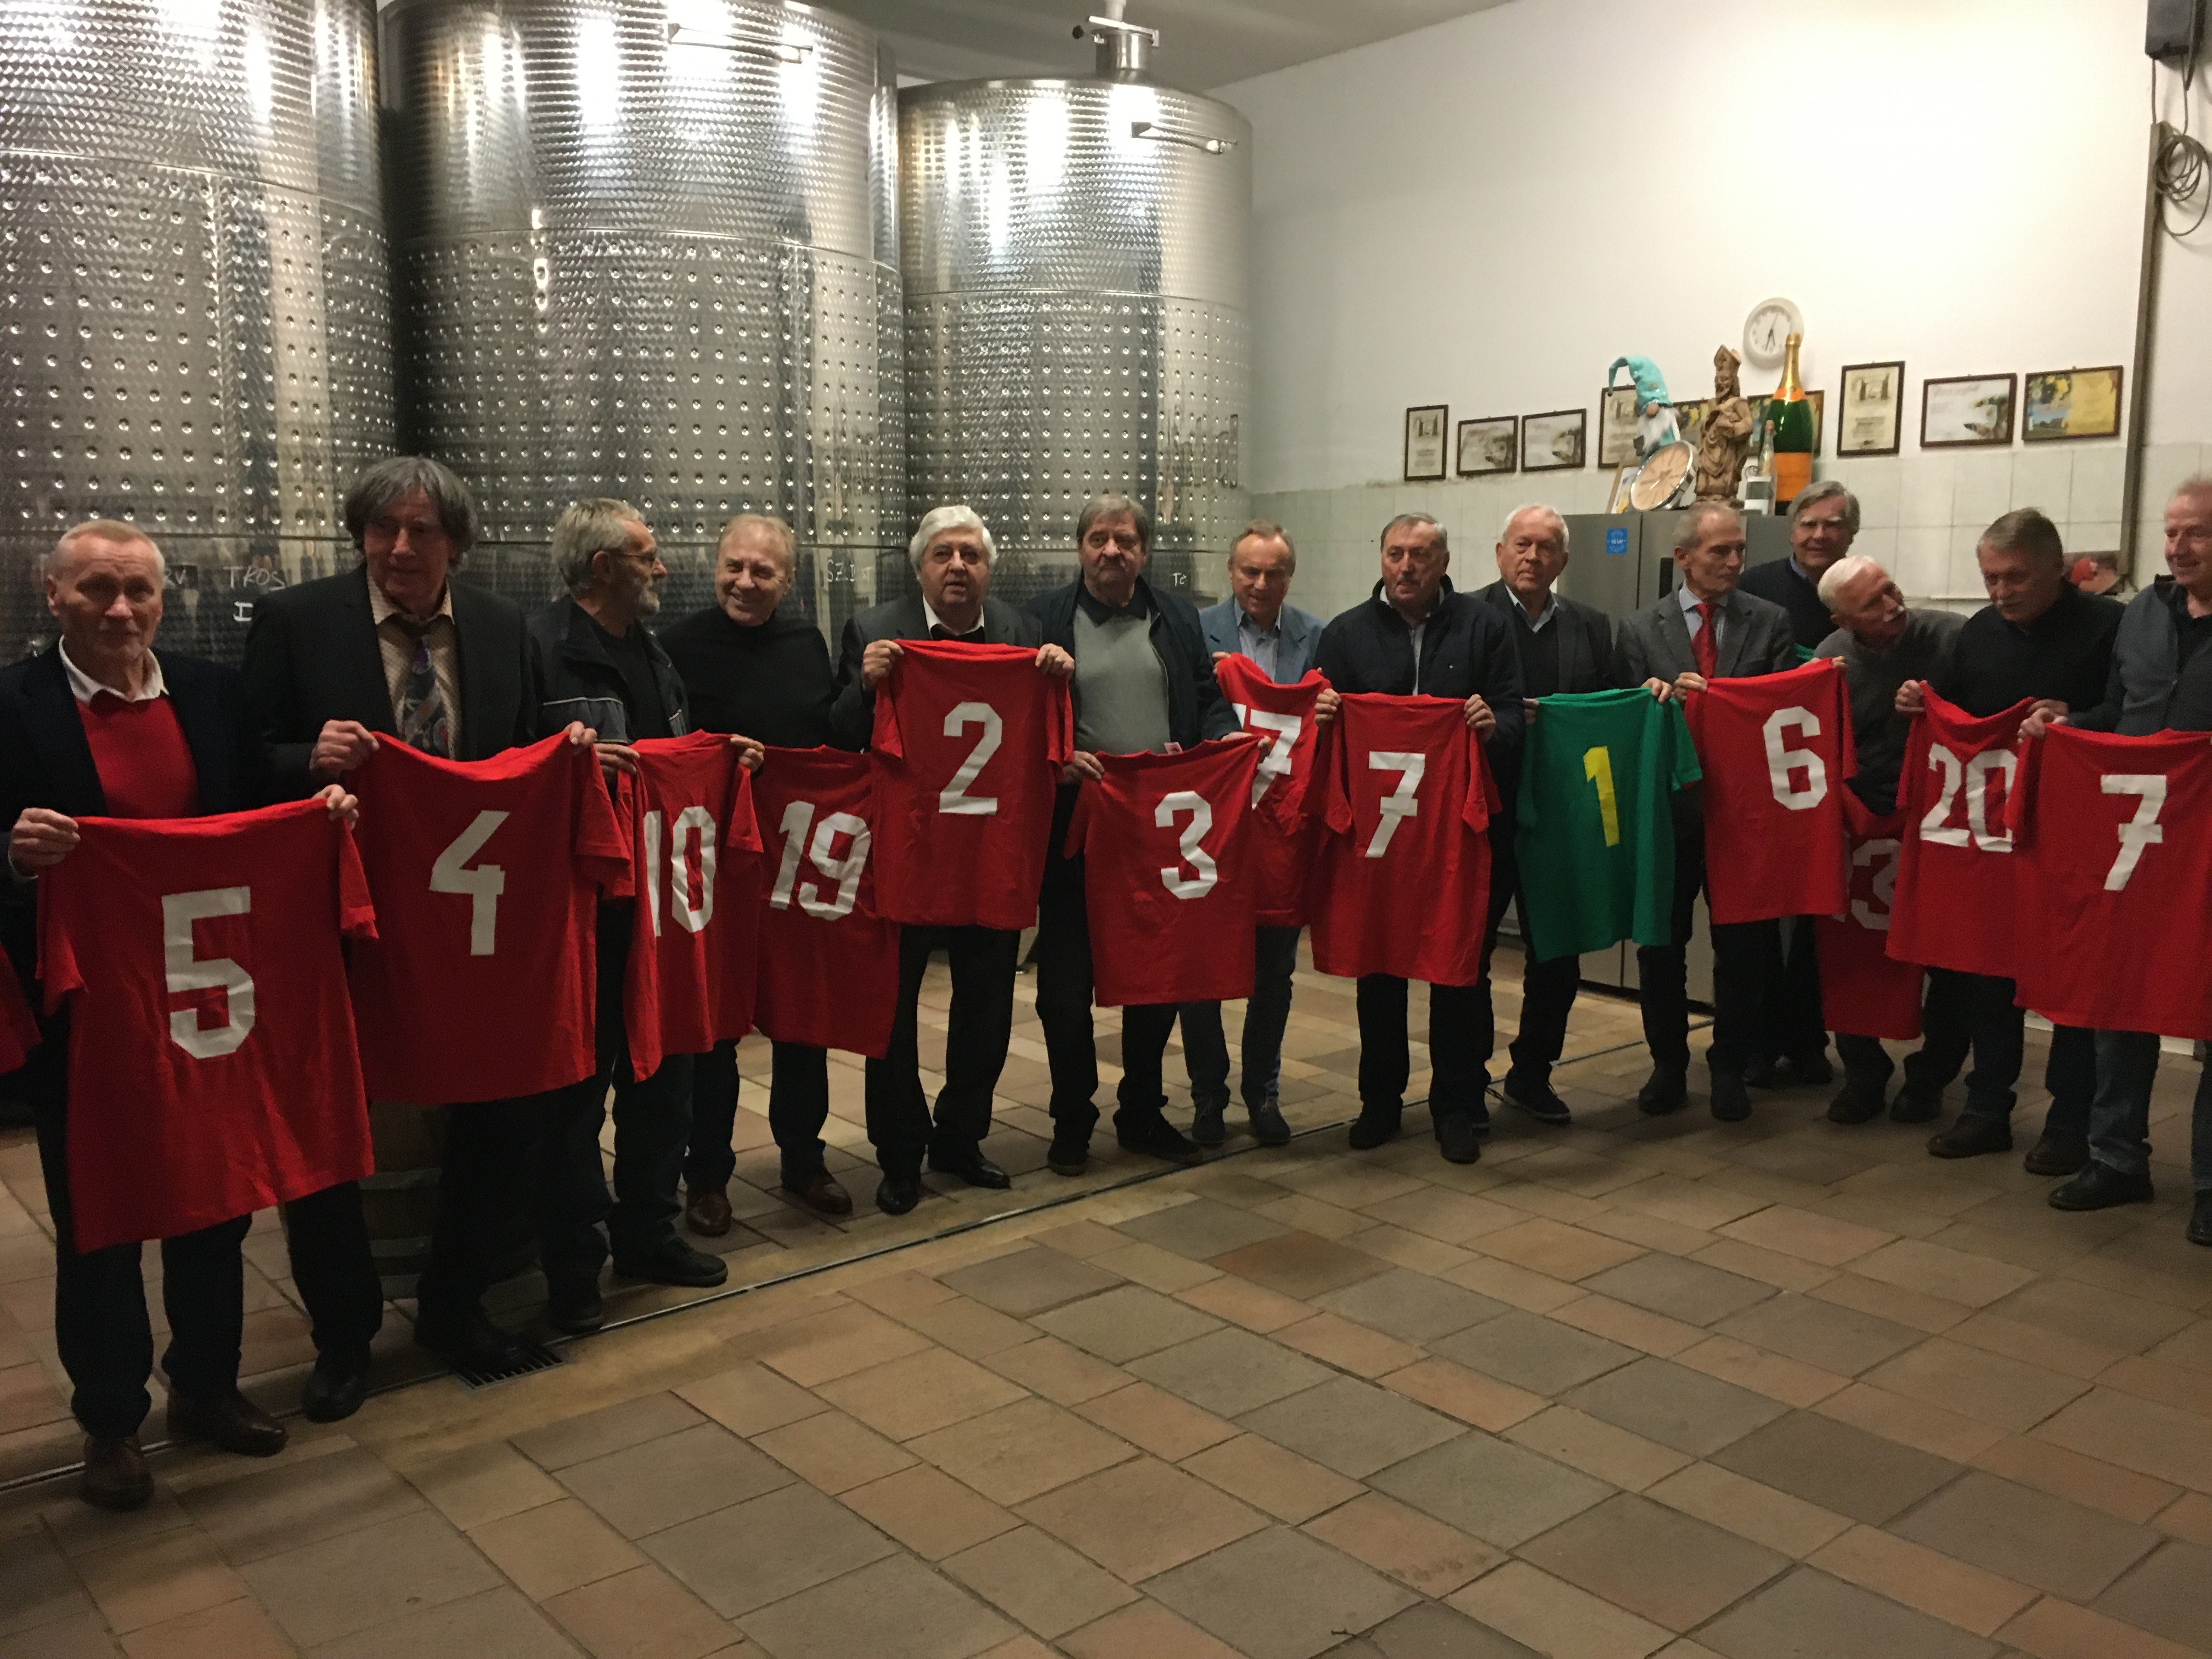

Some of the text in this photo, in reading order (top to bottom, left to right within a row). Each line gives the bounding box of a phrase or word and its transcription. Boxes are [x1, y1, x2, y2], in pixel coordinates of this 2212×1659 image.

[939, 702, 1003, 815] 2
[1365, 751, 1426, 858] 7
[1583, 746, 1620, 848] 1
[1763, 706, 1827, 810] 6
[1920, 743, 2018, 853] 20
[428, 810, 510, 956] 4
[644, 806, 716, 937] 10
[770, 800, 871, 921] 19
[1154, 791, 1218, 900] 3
[2101, 774, 2167, 891] 7
[162, 886, 256, 1060] 5
